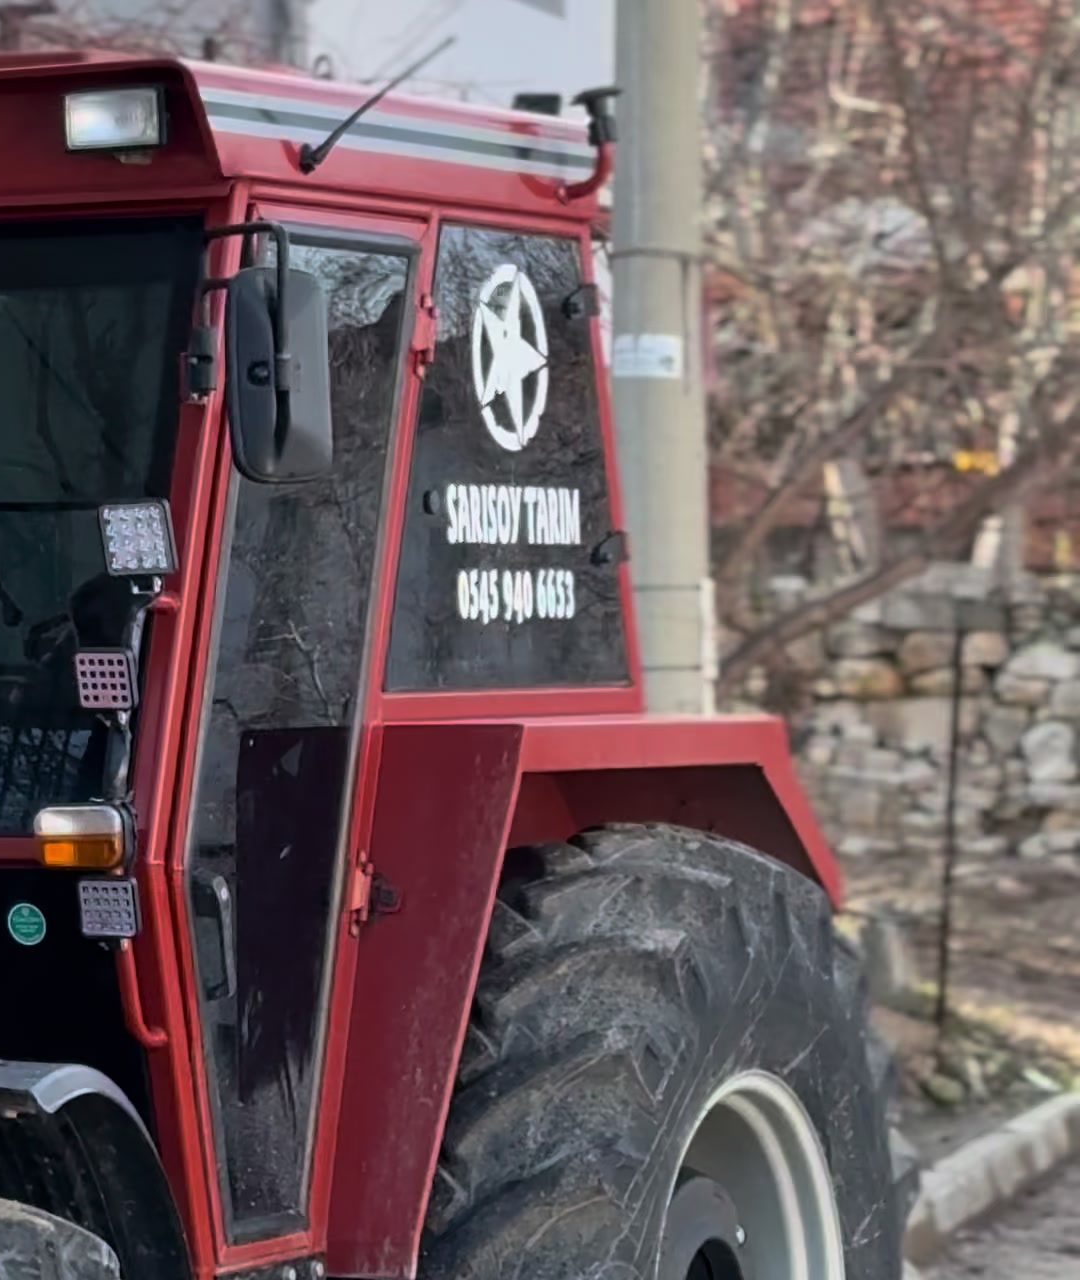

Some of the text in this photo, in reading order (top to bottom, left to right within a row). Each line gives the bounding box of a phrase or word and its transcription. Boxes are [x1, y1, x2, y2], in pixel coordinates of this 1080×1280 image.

[446, 483, 581, 545] SARISOY TARIM
[457, 568, 575, 625] 0545 940 6653
